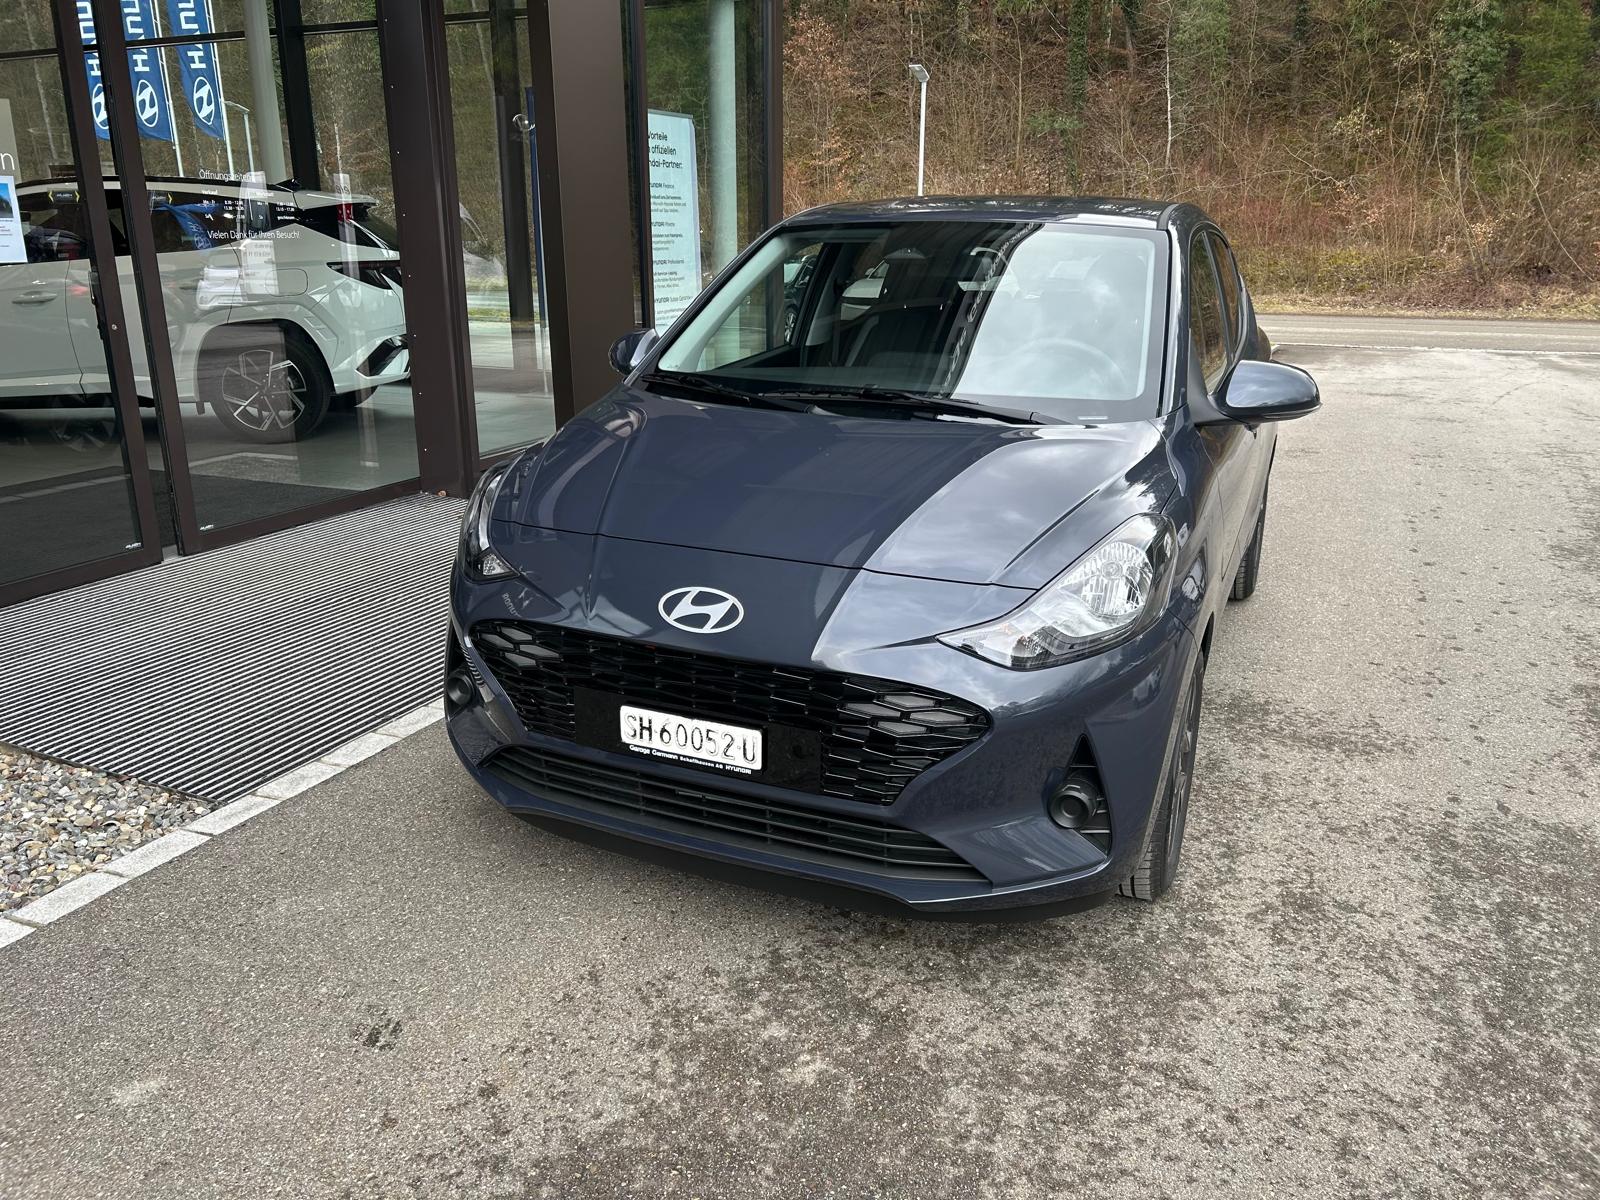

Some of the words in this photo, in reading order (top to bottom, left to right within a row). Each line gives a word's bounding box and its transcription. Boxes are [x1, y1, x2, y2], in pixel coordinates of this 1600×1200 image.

[652, 145, 677, 156] offiziellen
[199, 169, 251, 182] Öffnungseiten
[207, 230, 229, 239] Vielen
[229, 230, 247, 239] Dank
[248, 230, 258, 239] für
[259, 230, 276, 239] Ihren
[276, 230, 300, 239] Besuch!
[629, 744, 651, 755] Garage
[651, 748, 679, 761] Germann
[679, 755, 715, 767] Schaffhausen
[725, 764, 752, 775] HYUNDAI
